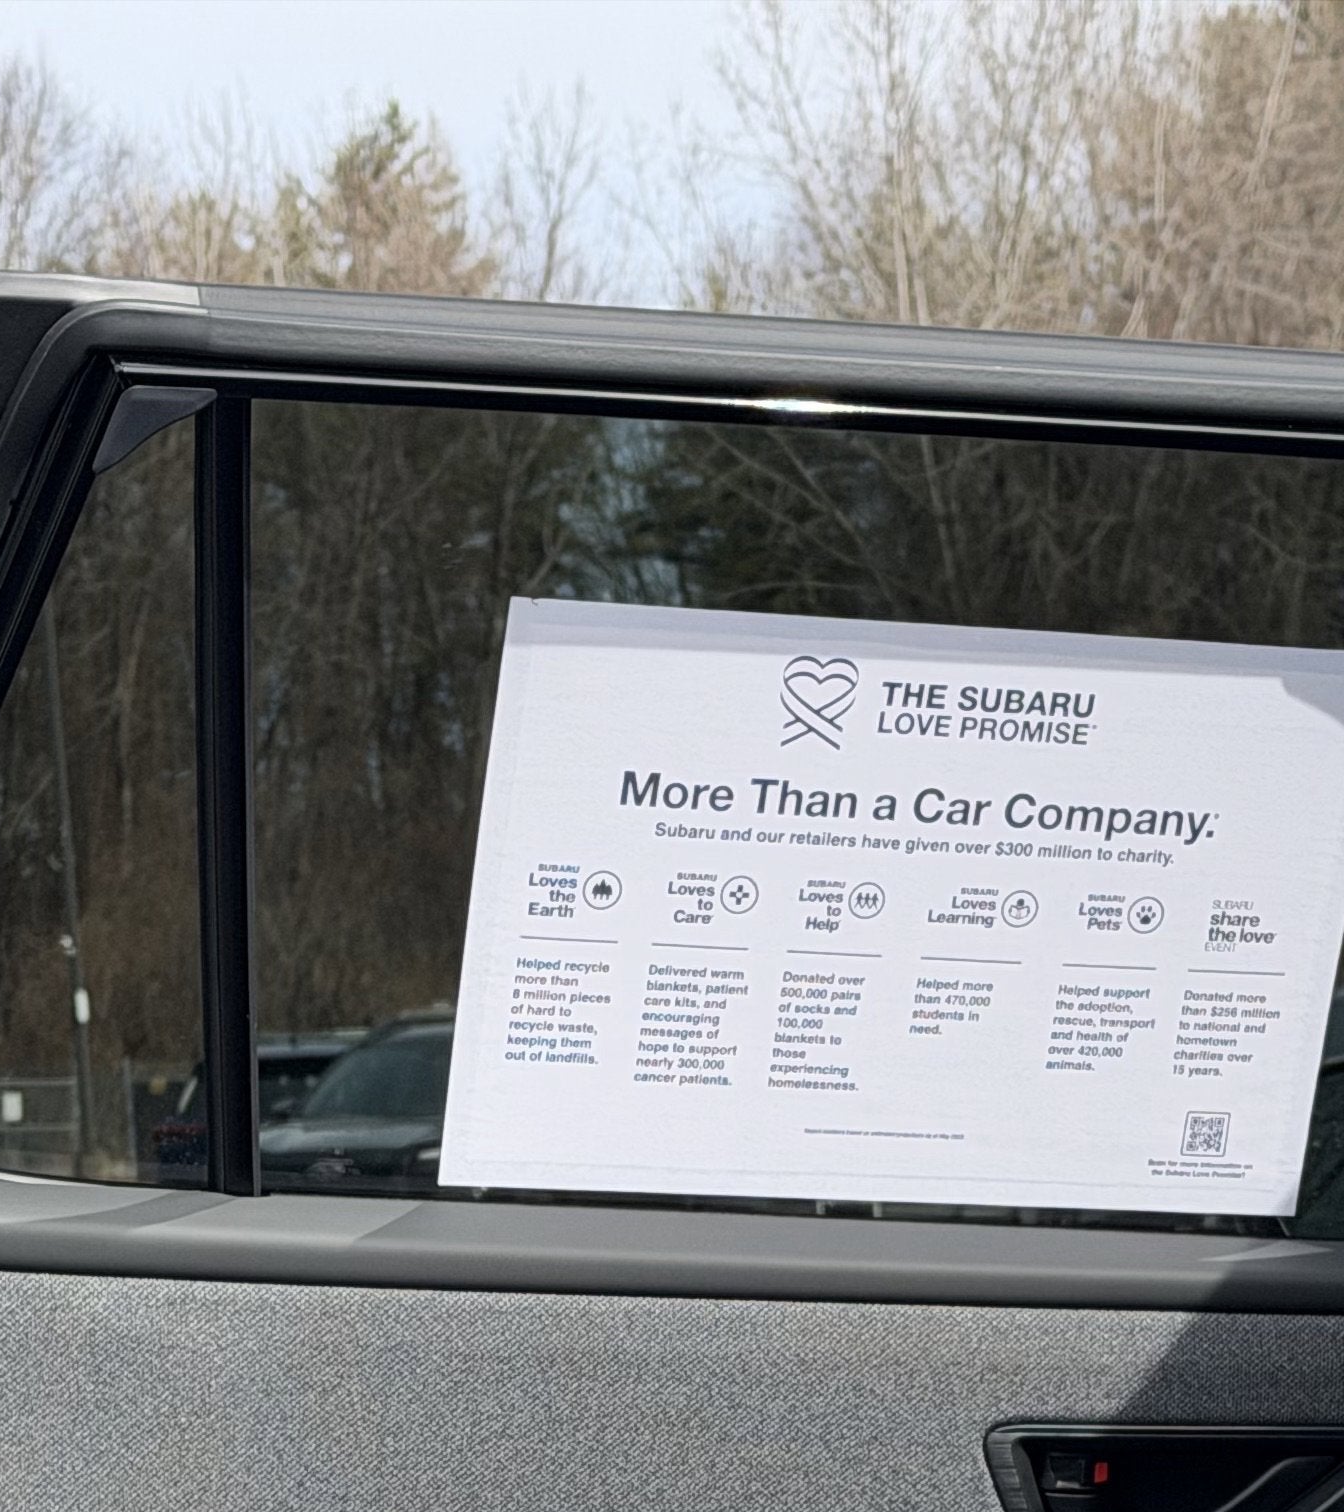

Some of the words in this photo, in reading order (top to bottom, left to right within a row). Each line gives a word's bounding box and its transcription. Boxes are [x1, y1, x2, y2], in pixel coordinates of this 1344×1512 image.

[881, 682, 948, 709] THE
[956, 686, 1096, 718] SUBARU
[878, 712, 952, 737] LOVE
[620, 771, 734, 811] More
[751, 778, 858, 818] Than
[873, 797, 896, 821] a
[913, 789, 992, 828] Car
[655, 822, 715, 840] Subaru
[720, 827, 751, 842] and
[756, 831, 785, 844] our
[790, 831, 856, 848] retailers
[862, 835, 901, 850] have
[905, 838, 950, 854] given
[955, 842, 990, 855] over
[995, 840, 1033, 857] $300
[1037, 843, 1092, 859] million
[1097, 846, 1112, 861] to
[1117, 846, 1175, 865] charity.
[538, 864, 580, 873] SUBARU
[529, 873, 577, 888] Loves
[677, 873, 717, 882] SUBARU
[807, 880, 846, 888] SUBARU
[668, 882, 715, 896] Loves
[799, 889, 843, 902] Loves
[961, 888, 998, 896] SUBARU
[549, 890, 576, 903] the
[952, 896, 996, 910] Loves
[528, 903, 574, 918] Earth
[698, 900, 713, 911] to
[827, 905, 841, 916] to
[1079, 903, 1122, 916] Loves
[1212, 900, 1254, 910] SUBARU
[674, 911, 712, 924] Care
[928, 910, 994, 928] Learning
[1210, 912, 1260, 927] share
[805, 917, 840, 933] Help
[1087, 918, 1121, 931] Pets
[1208, 929, 1236, 942] the
[1239, 929, 1275, 944] love
[1205, 943, 1237, 952] EVENT
[516, 958, 560, 972] Helped
[565, 961, 609, 974] recycle
[649, 965, 707, 978] Delivered
[711, 970, 744, 980] warm
[515, 975, 547, 985] more
[551, 975, 578, 986] than
[783, 972, 835, 985] Donated
[838, 976, 865, 986] over
[917, 978, 959, 991] Helped
[962, 982, 993, 991] more
[647, 980, 702, 994] blankets,
[705, 984, 748, 996] patient
[1058, 985, 1099, 998] Helped
[1103, 988, 1150, 1000] support
[524, 990, 566, 1001] million
[569, 993, 611, 1004] pieces
[831, 991, 861, 1001] pairs
[914, 994, 941, 1004] than
[1184, 990, 1233, 1003] Donated
[1236, 995, 1266, 1003] more
[644, 997, 671, 1007] care
[674, 997, 700, 1009] kits,
[704, 999, 726, 1009] and
[779, 1003, 791, 1013] of
[795, 1004, 830, 1014] socks
[834, 1006, 857, 1016] and
[1056, 1001, 1074, 1010] the
[1078, 1002, 1133, 1014] adoption,
[511, 1004, 523, 1015] of
[527, 1005, 555, 1016] hard
[559, 1007, 571, 1016] to
[912, 1009, 964, 1021] students
[968, 1012, 979, 1021] in
[1181, 1006, 1206, 1016] than
[1241, 1009, 1280, 1019] million
[642, 1012, 720, 1026] encouraging
[1053, 1016, 1096, 1027] rescue,
[1100, 1018, 1155, 1030] transport
[509, 1020, 554, 1032] recycle
[558, 1023, 598, 1035] waste,
[640, 1028, 702, 1040] messages
[707, 1029, 719, 1039] of
[909, 1025, 942, 1035] need.
[1179, 1021, 1190, 1031] to
[1194, 1022, 1240, 1032] national
[1244, 1024, 1266, 1034] and
[507, 1035, 557, 1049] keeping
[561, 1037, 592, 1048] them
[774, 1033, 825, 1045] blankets
[830, 1035, 842, 1045] to
[1051, 1031, 1072, 1040] and
[1077, 1031, 1112, 1042] health
[1116, 1033, 1129, 1042] of
[1176, 1036, 1237, 1047] hometown
[638, 1042, 669, 1054] hope
[672, 1043, 685, 1053] to
[689, 1044, 737, 1056] support
[772, 1048, 806, 1059] those
[1048, 1047, 1074, 1055] over
[505, 1051, 526, 1061] out
[529, 1051, 542, 1061] of
[545, 1052, 599, 1064] landfills.
[1174, 1051, 1223, 1062] charities
[1227, 1053, 1253, 1063] over
[636, 1058, 673, 1070] nearly
[770, 1063, 849, 1077] experiencing
[1046, 1061, 1095, 1071] animals.
[1173, 1065, 1184, 1075] 15
[1188, 1066, 1222, 1077] years.
[634, 1074, 676, 1083] cancer
[679, 1074, 732, 1086] patients.
[768, 1078, 859, 1091] homelessness.
